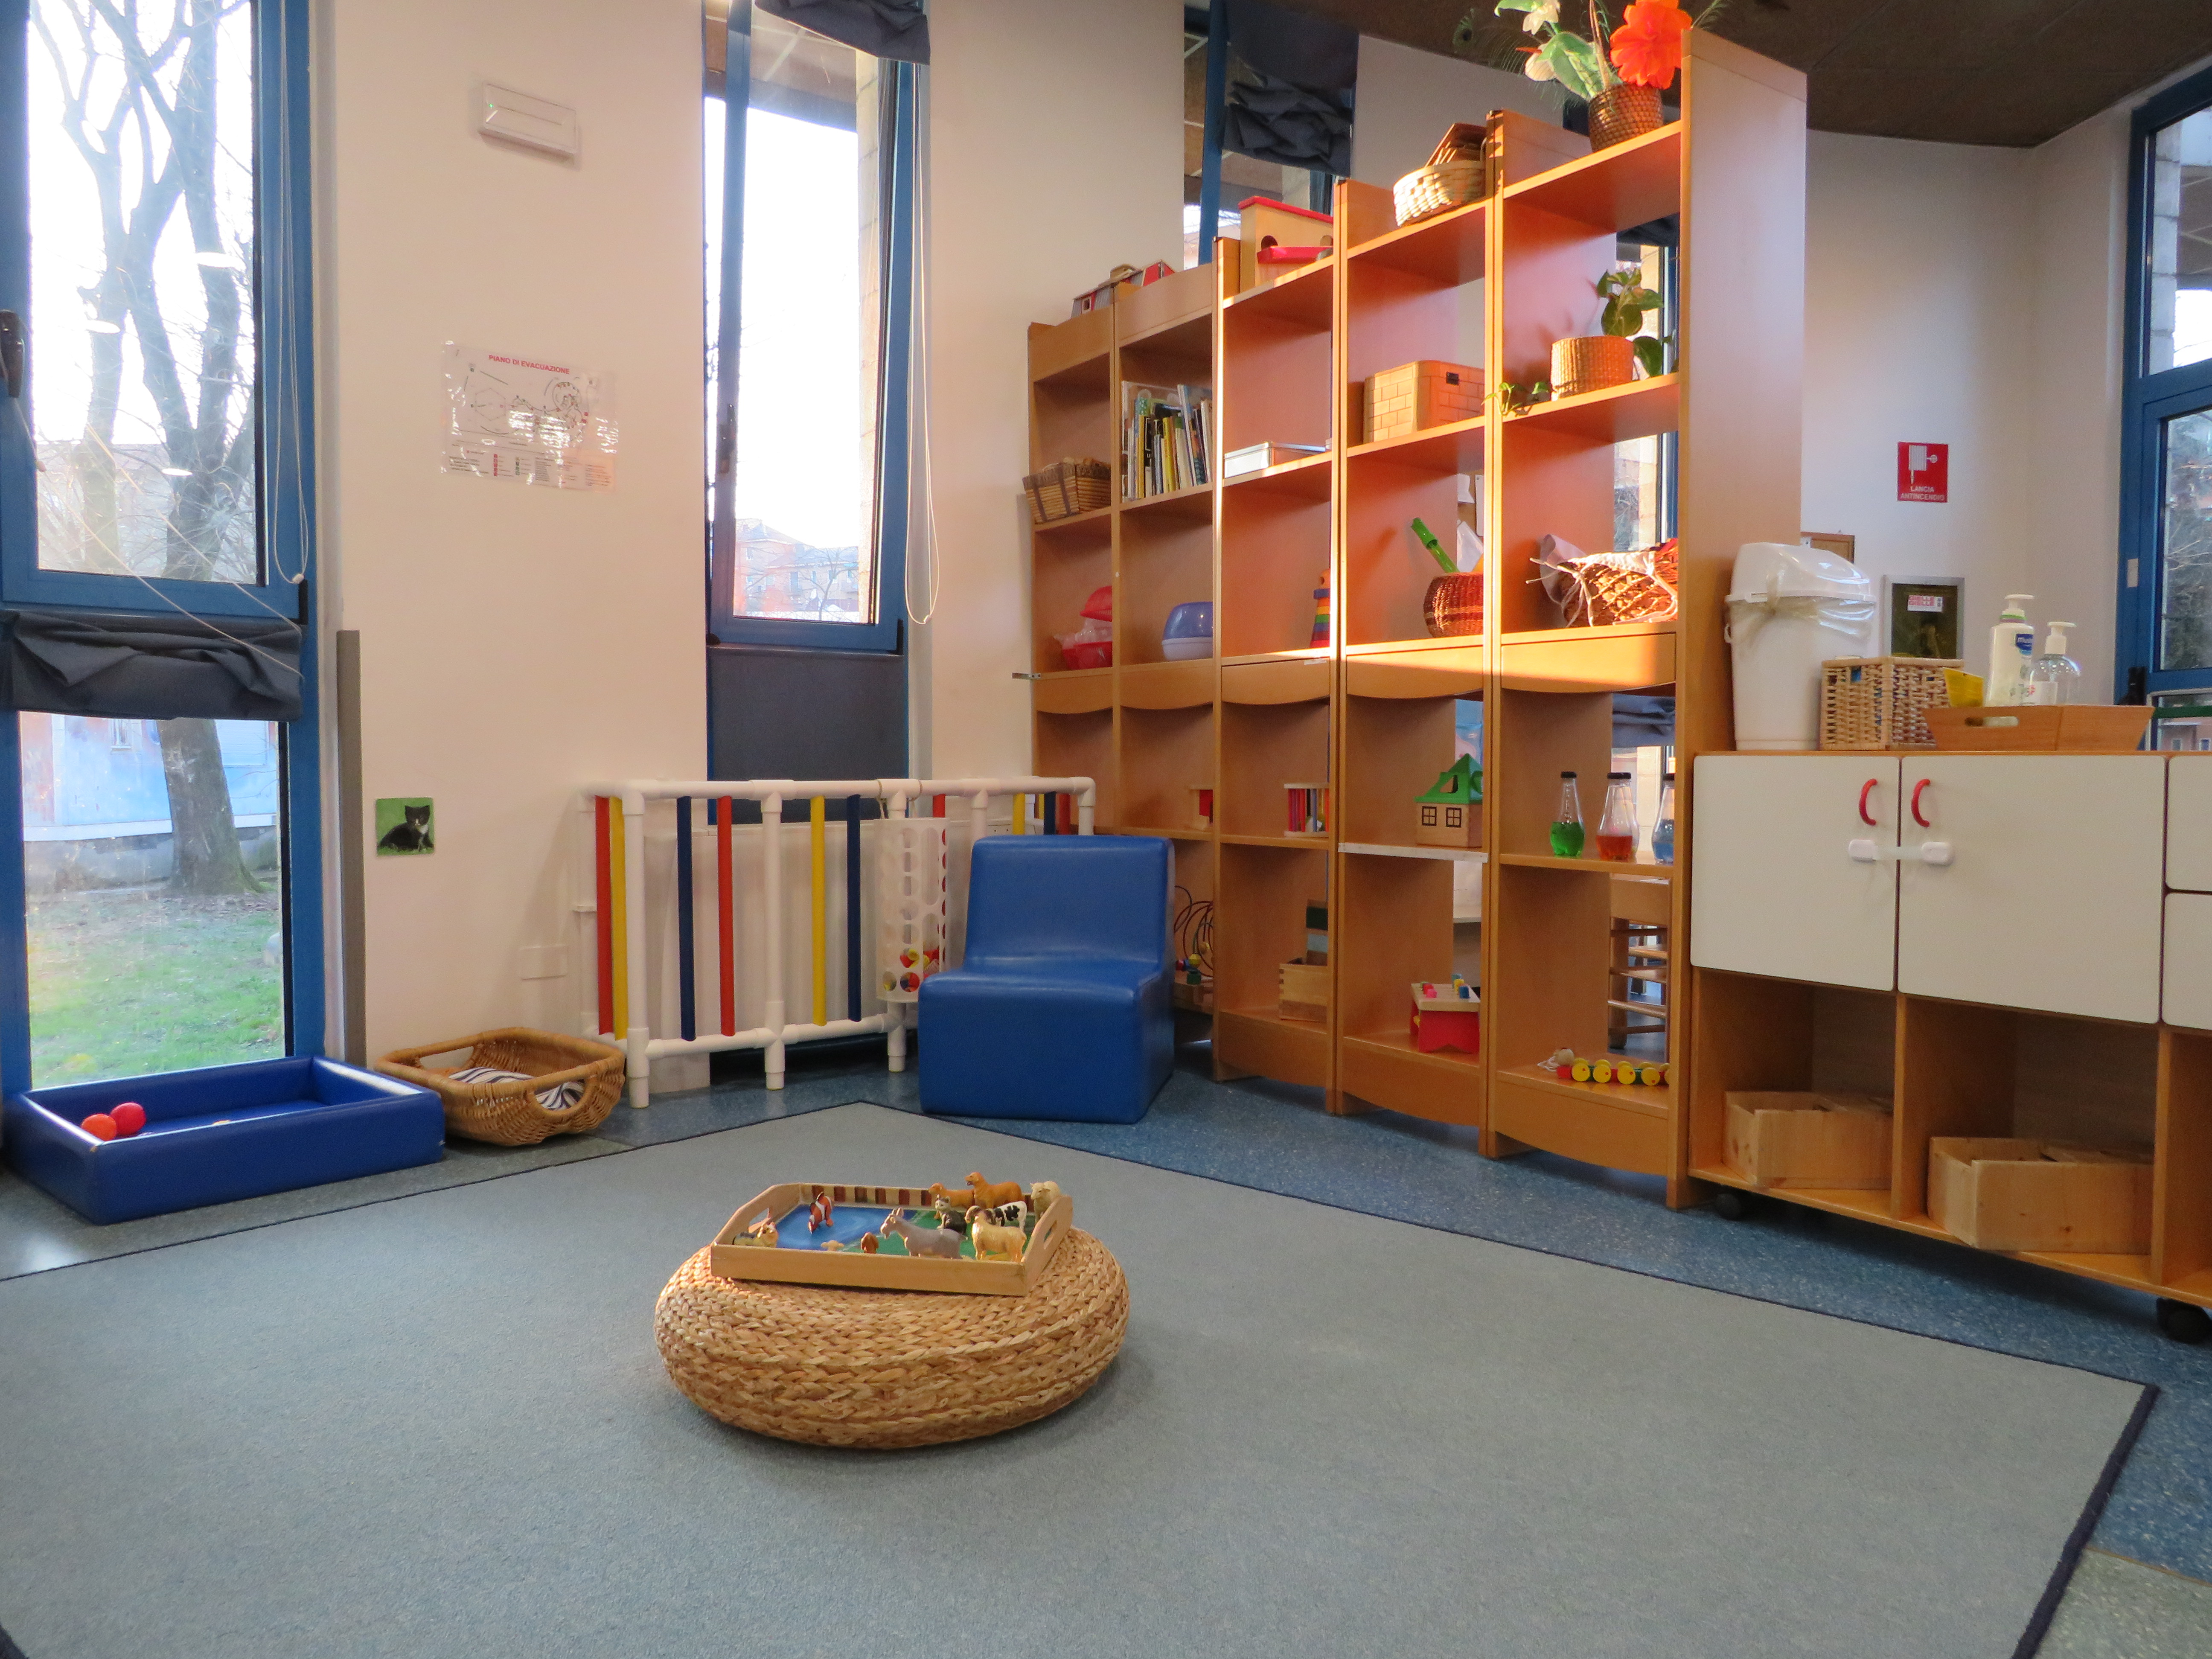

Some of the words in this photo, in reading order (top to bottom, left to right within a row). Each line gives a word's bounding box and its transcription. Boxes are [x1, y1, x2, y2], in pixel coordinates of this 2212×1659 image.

[488, 354, 511, 364] PIANO
[521, 360, 570, 375] EVACUAZIONE
[1901, 493, 1945, 501] ANTINCENDIO
